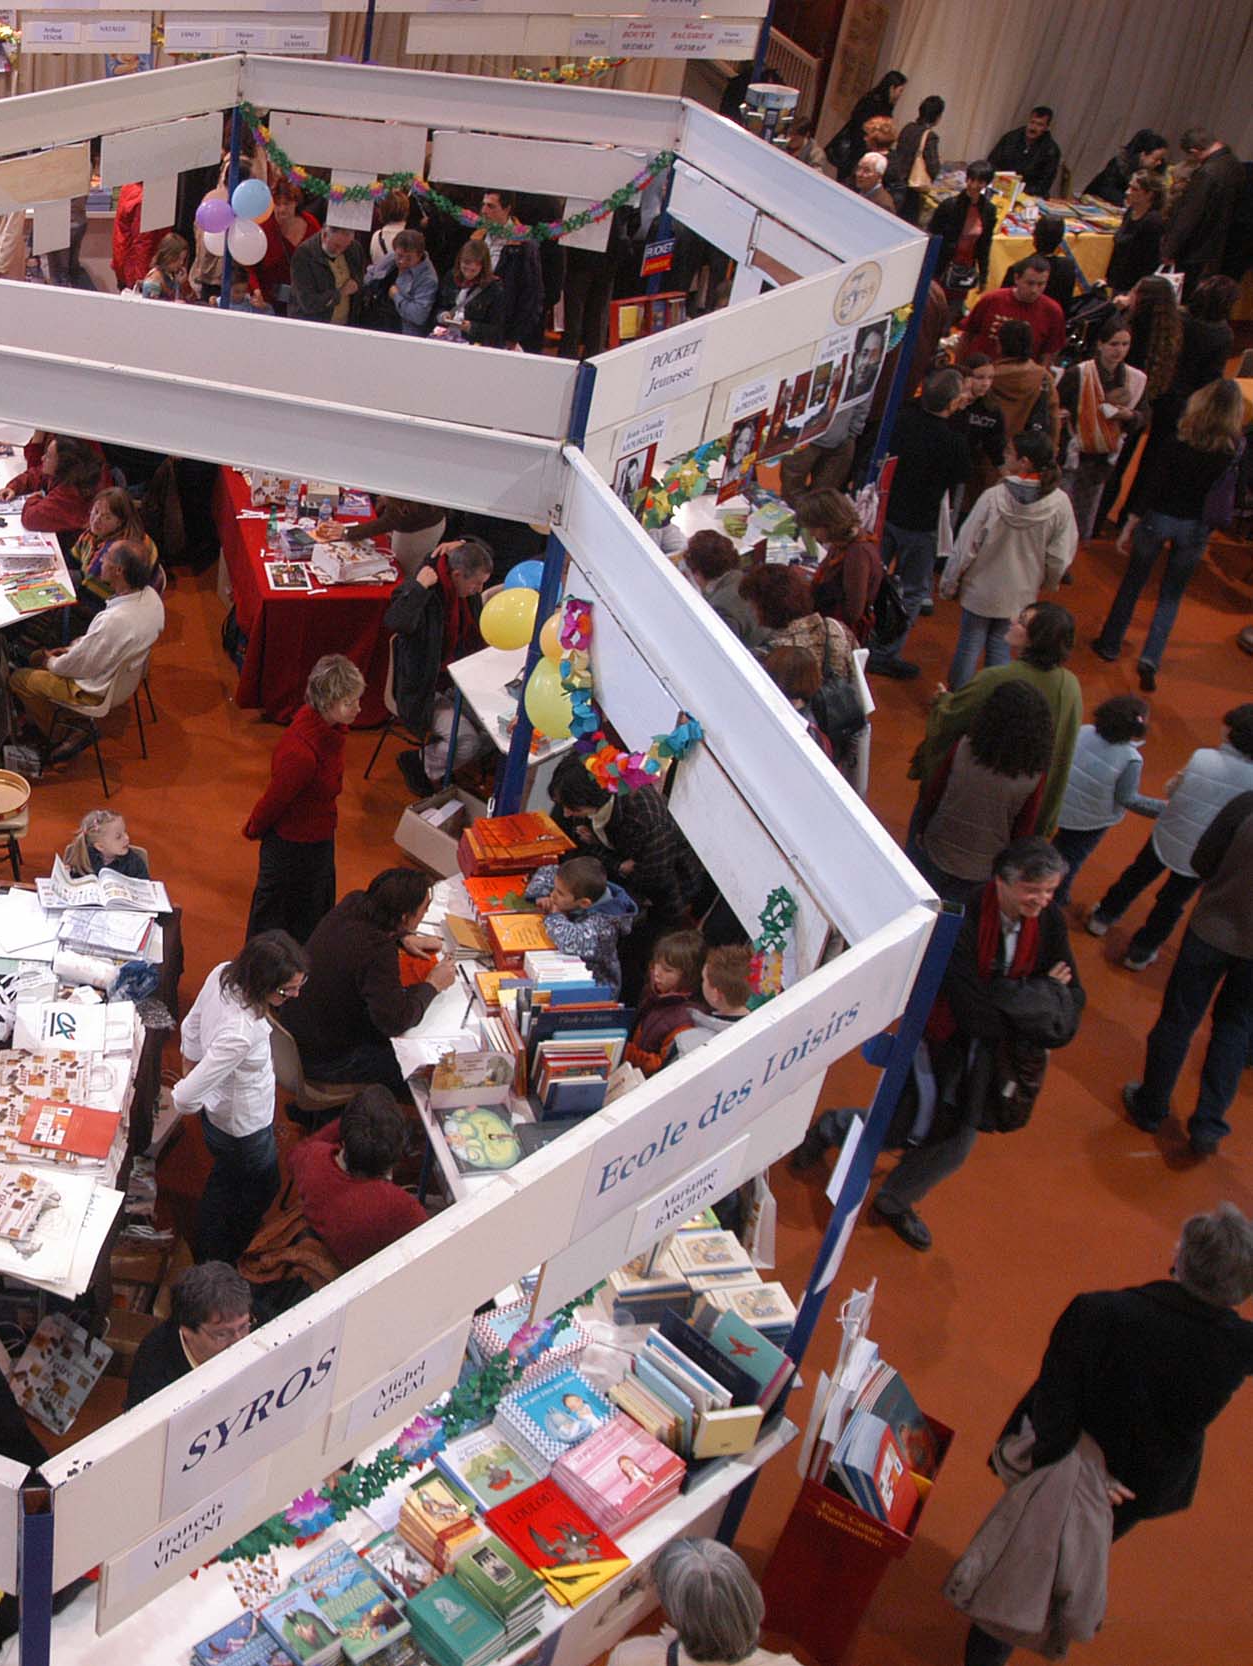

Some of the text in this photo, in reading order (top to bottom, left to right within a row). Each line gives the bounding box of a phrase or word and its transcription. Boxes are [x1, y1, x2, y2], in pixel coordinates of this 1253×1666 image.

[650, 339, 703, 371] POCKET
[645, 366, 694, 398] Jeunesse
[597, 1001, 861, 1196] Ecole des Loisirs
[660, 1167, 719, 1209] Marianne
[373, 1380, 425, 1418] COSEM
[378, 1360, 426, 1402] Michel
[182, 1347, 336, 1472] SYROS
[154, 1514, 222, 1569] VINCENT
